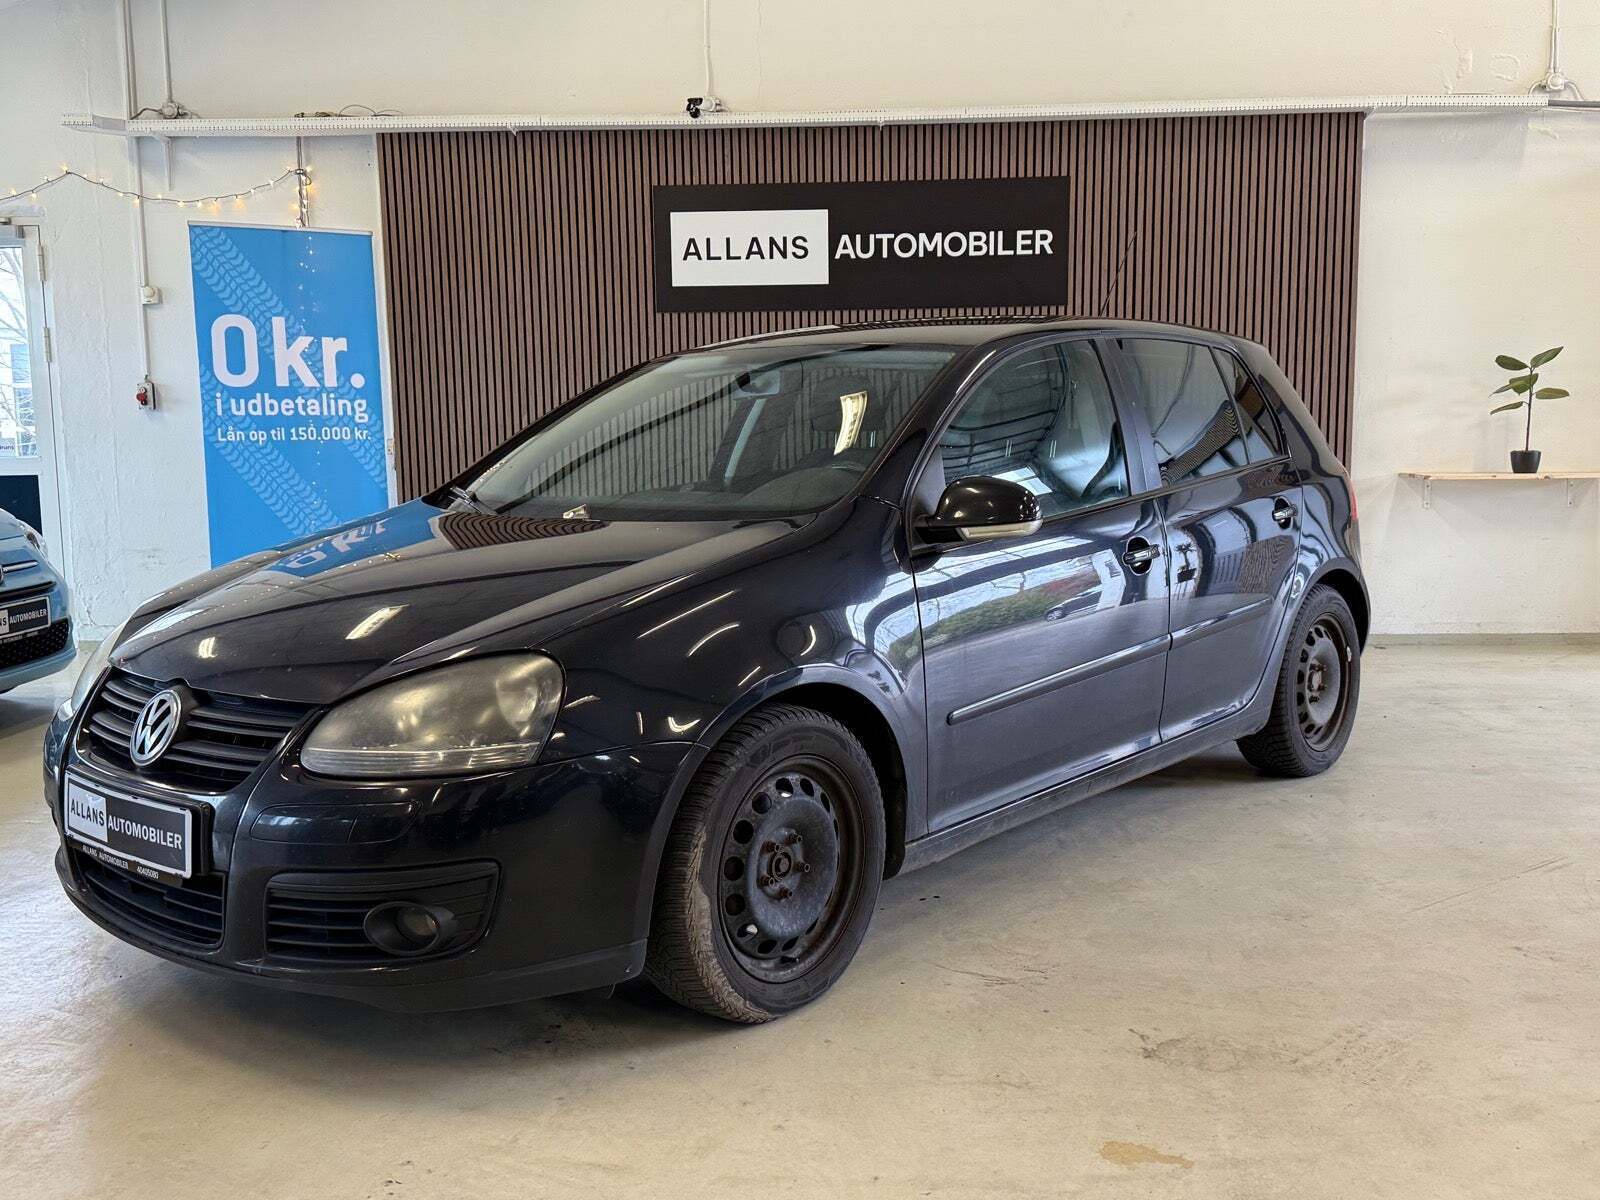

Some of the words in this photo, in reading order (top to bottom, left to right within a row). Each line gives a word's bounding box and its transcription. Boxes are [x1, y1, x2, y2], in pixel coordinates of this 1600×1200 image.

[682, 235, 810, 262] ALLANS
[834, 228, 1054, 259] AUTOMOBILER
[211, 314, 259, 388] 0
[271, 316, 366, 389] kr.
[215, 392, 223, 416] i
[230, 392, 369, 424] udbetaling
[217, 426, 245, 441] Lån
[249, 430, 267, 445] op
[270, 428, 286, 441] til
[290, 427, 351, 441] 150.000
[354, 427, 371, 440] kr.
[9, 608, 48, 625] AUTOMOBILER
[70, 798, 105, 827] ALLANS
[108, 815, 183, 850] AUTOMOBILER
[99, 849, 129, 870] AUTOMOBILER
